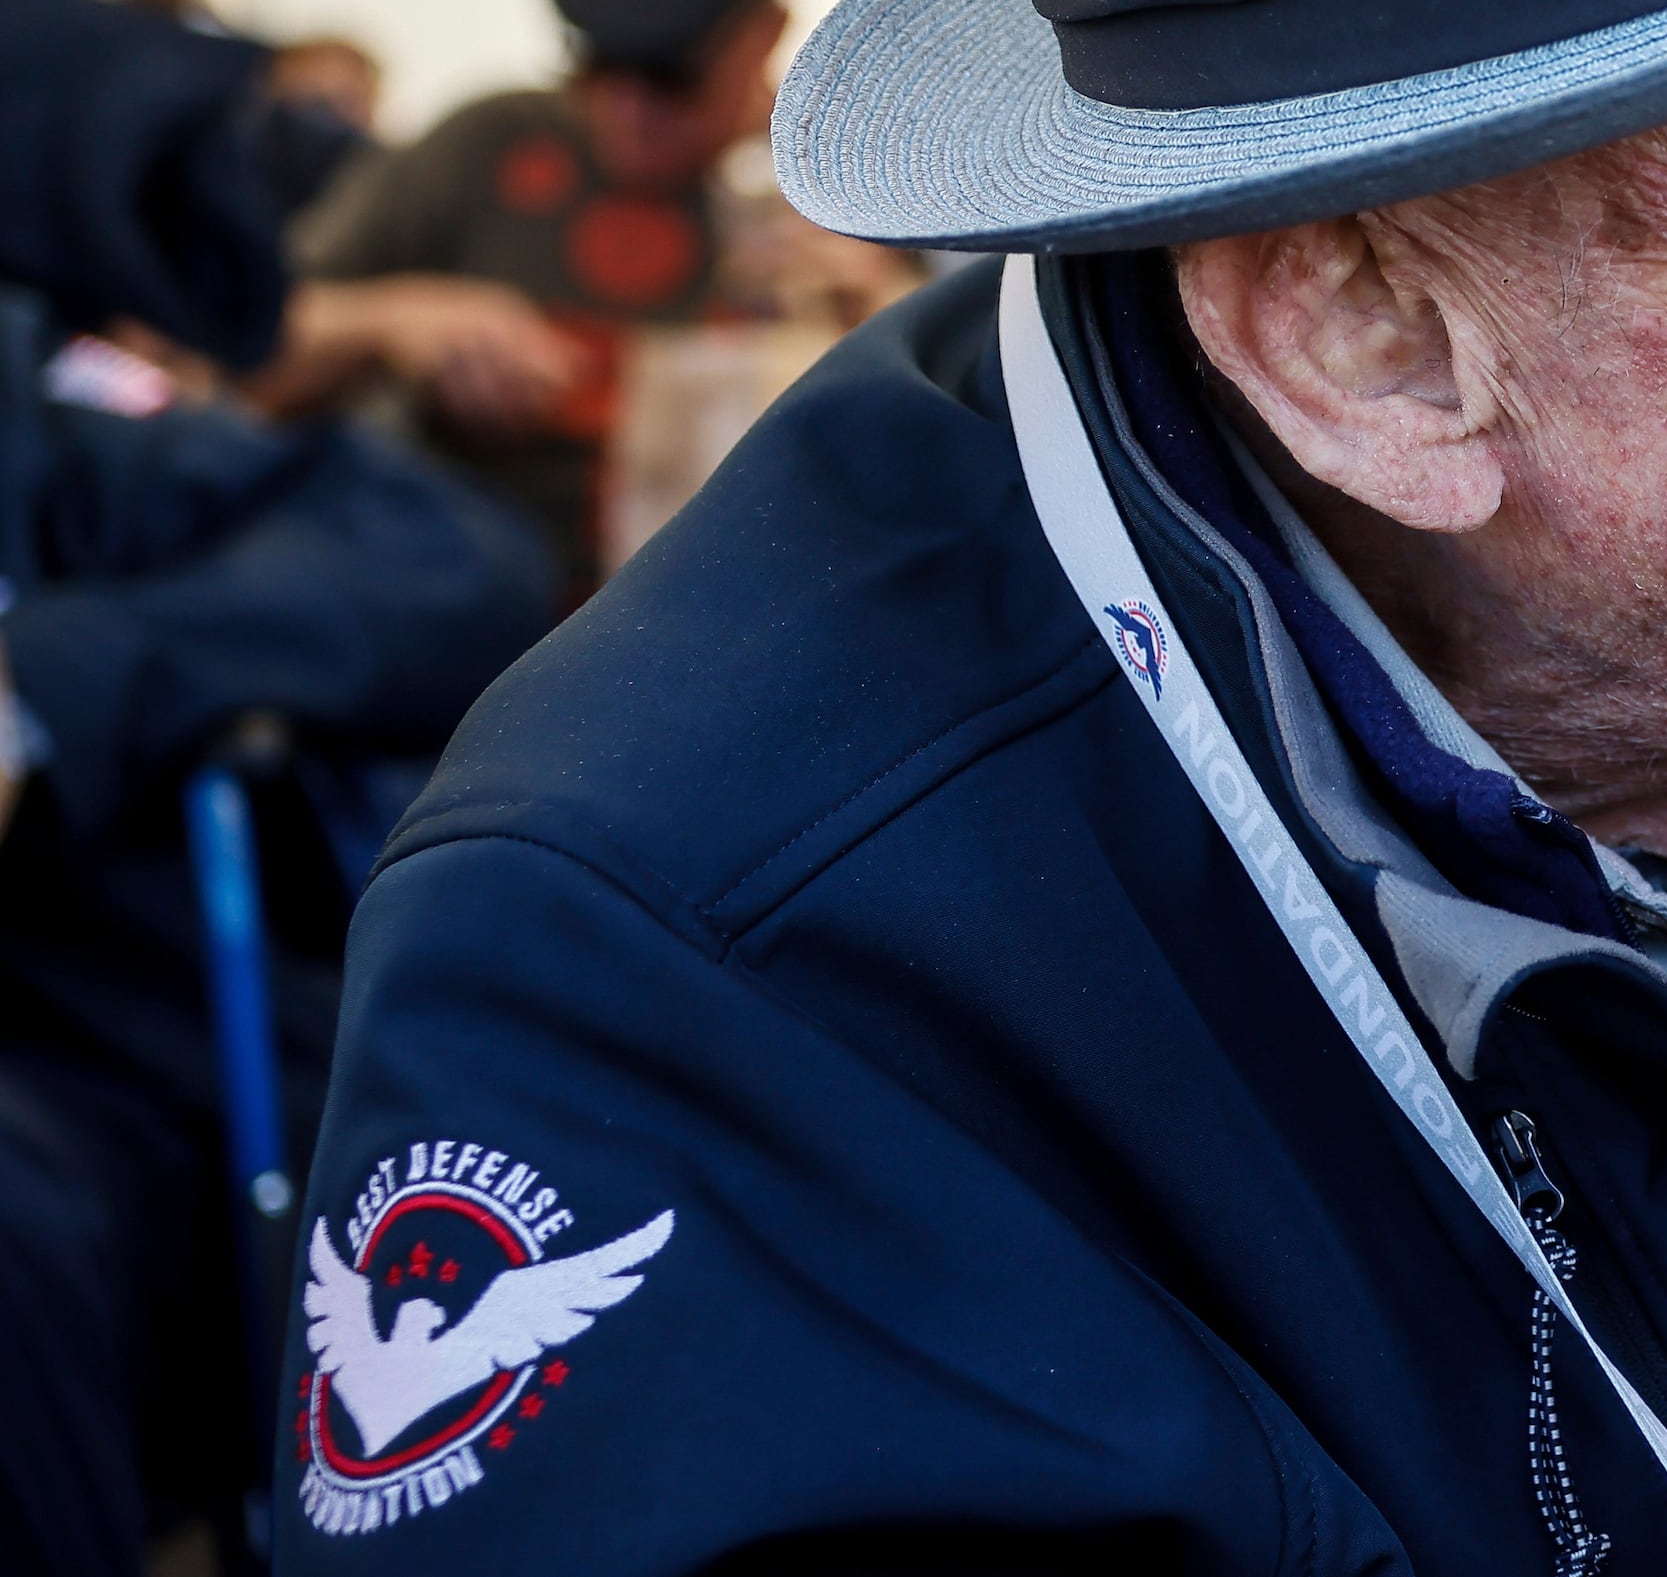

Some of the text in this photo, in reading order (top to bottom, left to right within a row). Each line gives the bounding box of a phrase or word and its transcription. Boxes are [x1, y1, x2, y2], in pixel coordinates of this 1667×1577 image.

[1173, 701, 1482, 1187] FOUNDATION
[347, 1139, 576, 1251] BEST DEFENSE
